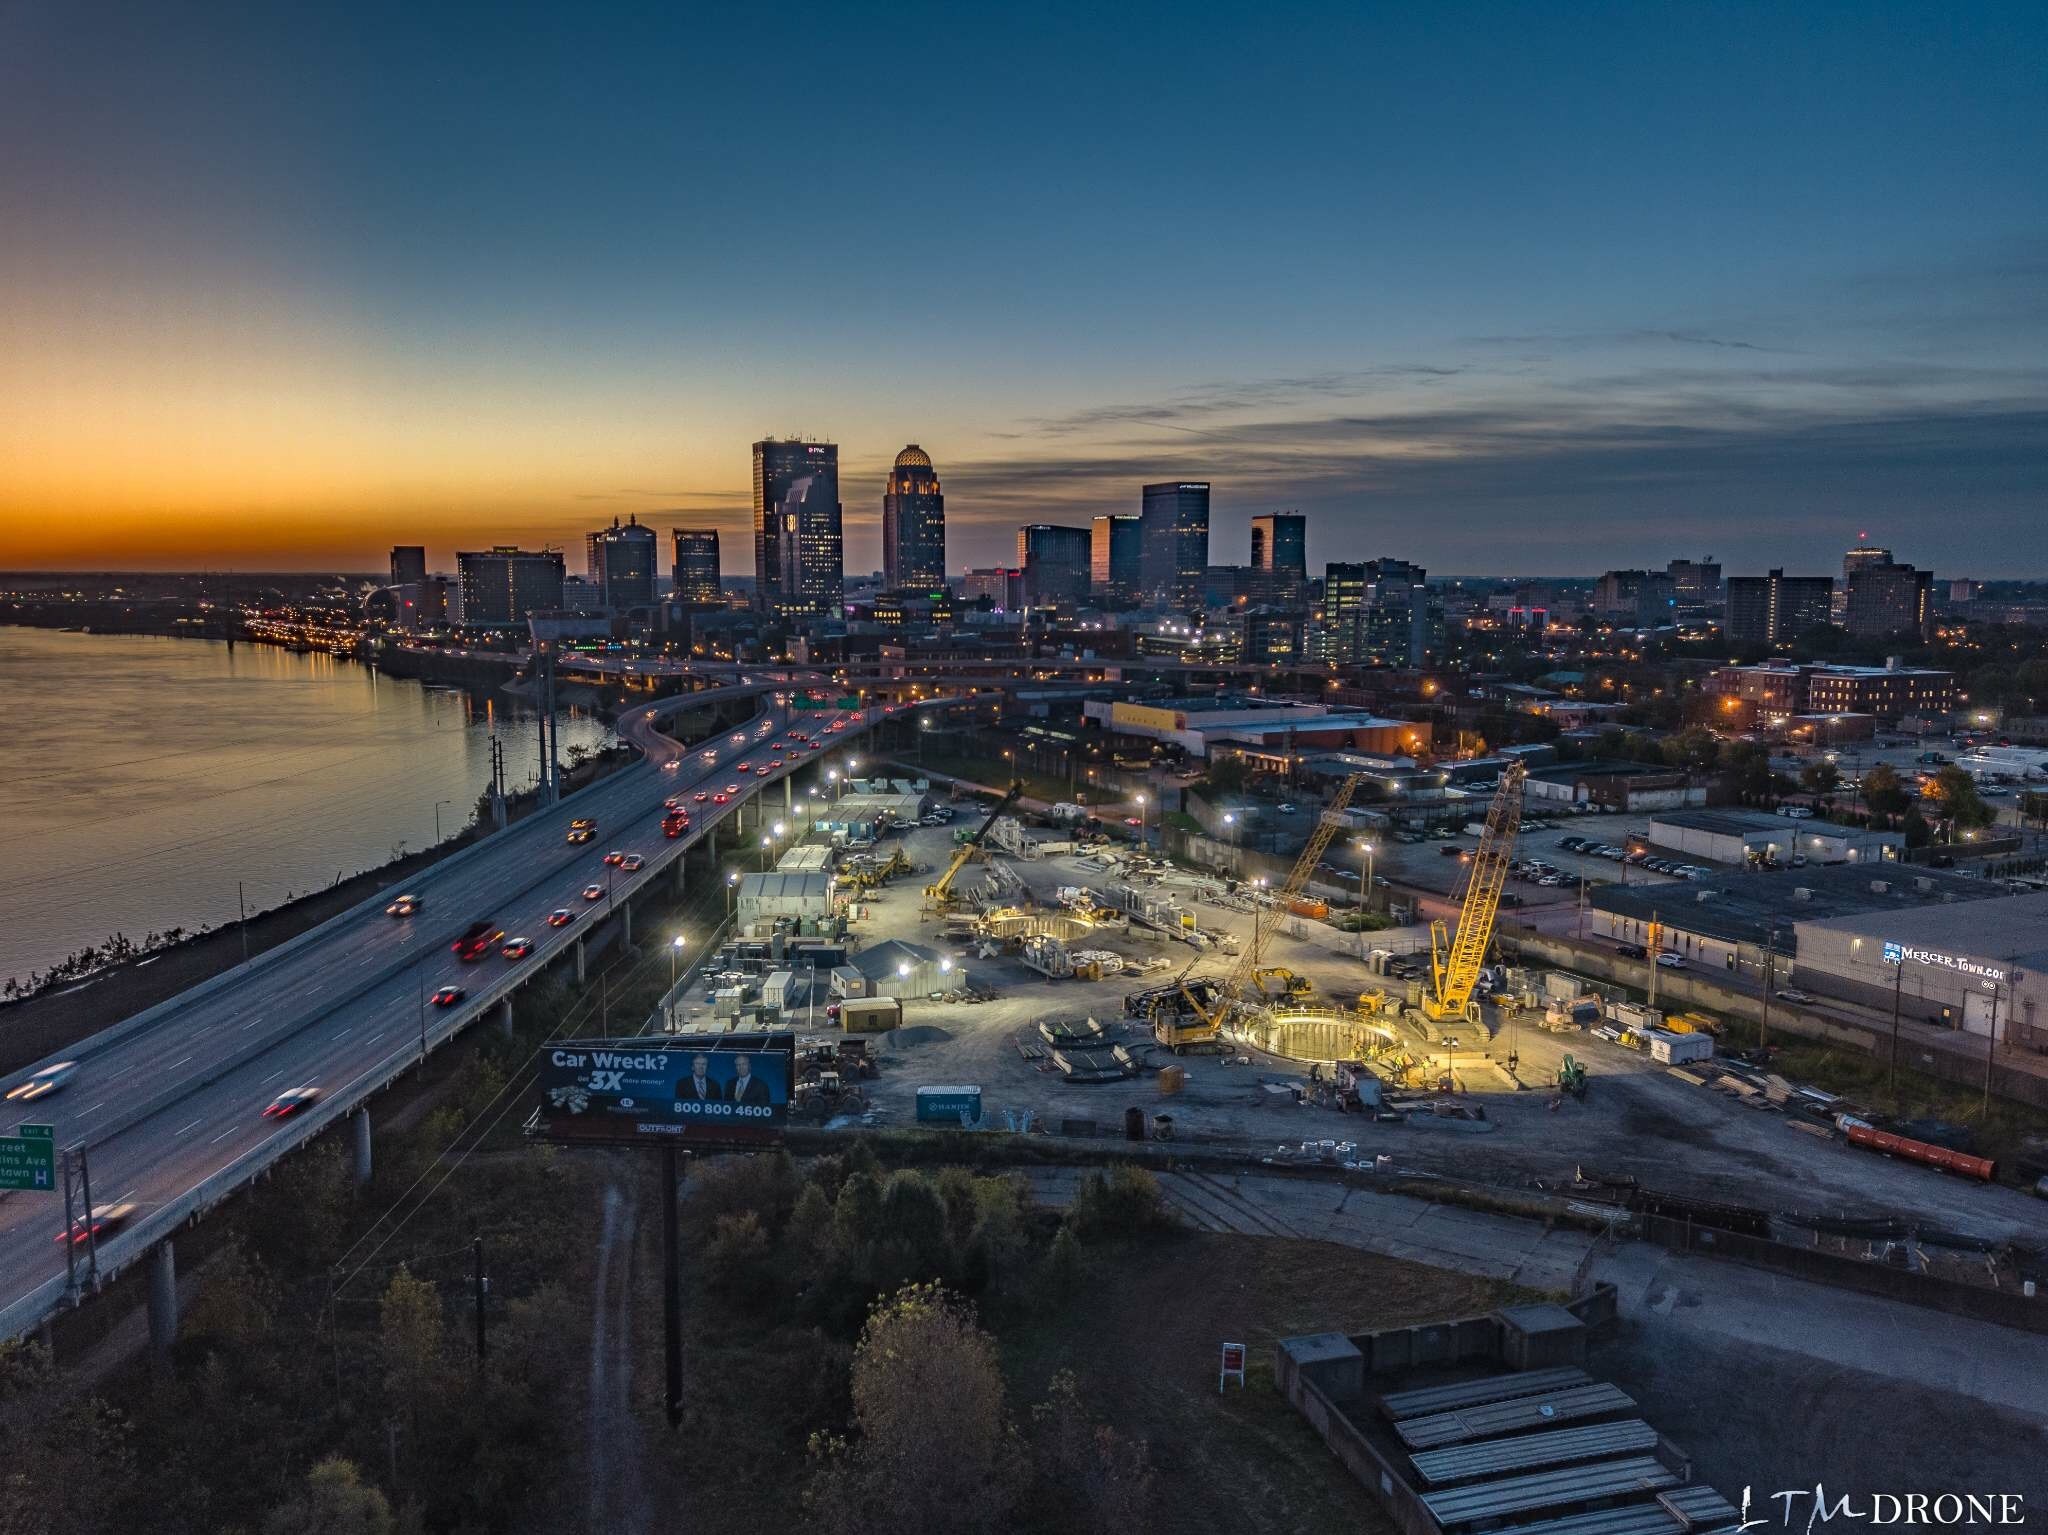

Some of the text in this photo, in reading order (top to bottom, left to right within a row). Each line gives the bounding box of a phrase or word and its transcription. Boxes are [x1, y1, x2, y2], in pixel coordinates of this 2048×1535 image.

[551, 1051, 668, 1071] Car Wreck?
[588, 1070, 625, 1091] 3X
[674, 1102, 772, 1117] 800 800 4600
[43, 1128, 49, 1136] 4
[639, 1124, 684, 1134] OUTFRONT
[0, 1144, 26, 1153] reet
[26, 1156, 47, 1166] Ave
[35, 1170, 47, 1185] H
